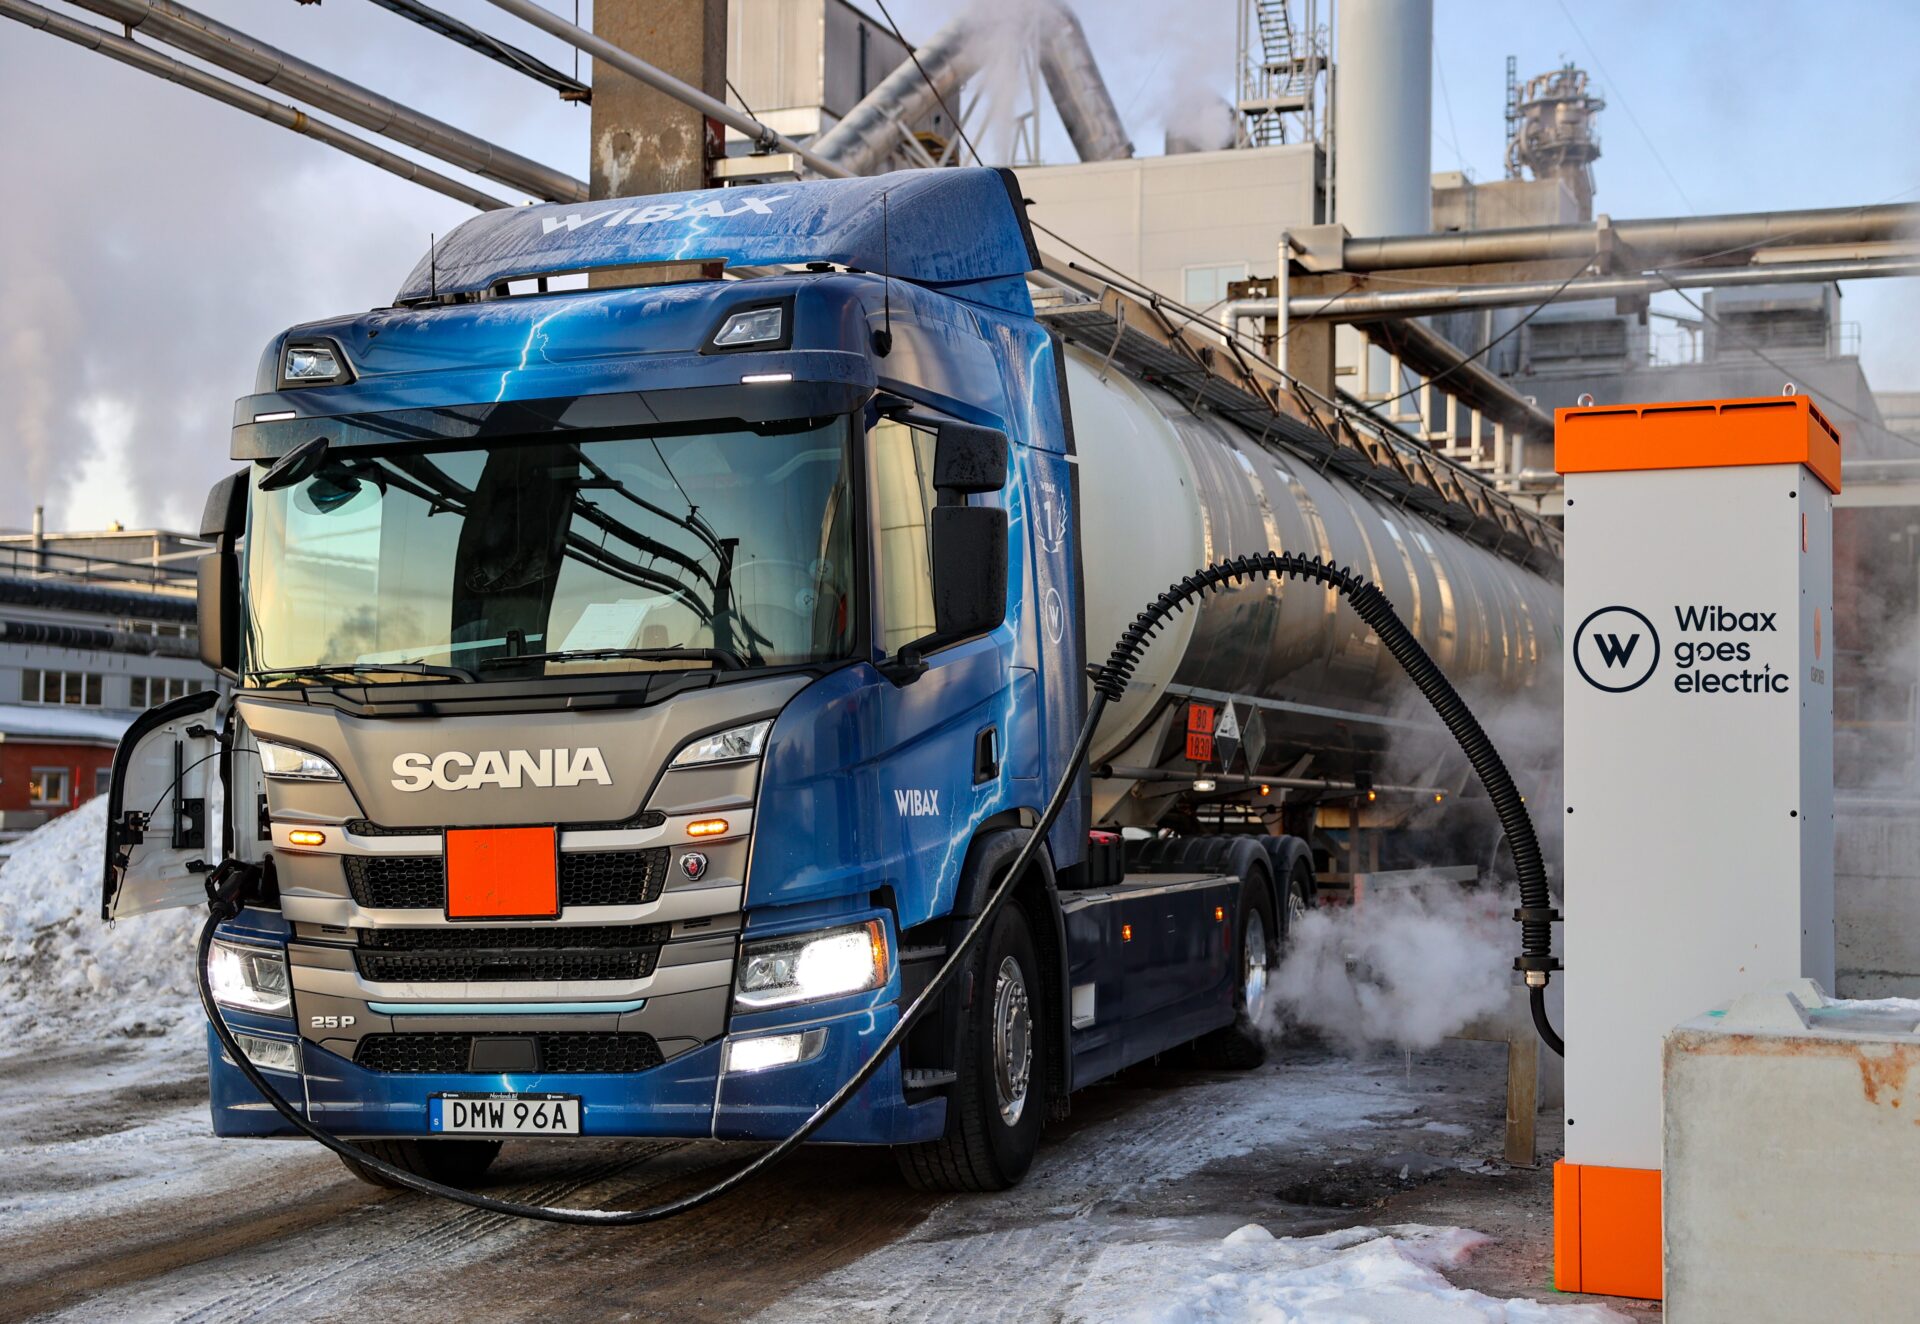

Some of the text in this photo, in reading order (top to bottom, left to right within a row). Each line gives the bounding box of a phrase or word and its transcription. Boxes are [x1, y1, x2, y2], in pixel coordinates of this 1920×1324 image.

[541, 195, 792, 235] WIBAX
[1674, 605, 1777, 631] Wibax
[1674, 641, 1751, 668] goes
[1674, 663, 1789, 693] electric
[1197, 709, 1207, 729] 80
[1191, 735, 1210, 757] 1830
[391, 747, 613, 792] SCANIA
[893, 789, 940, 817] WIBAX
[434, 1118, 439, 1126] S
[453, 1102, 567, 1129] DMW 96A
